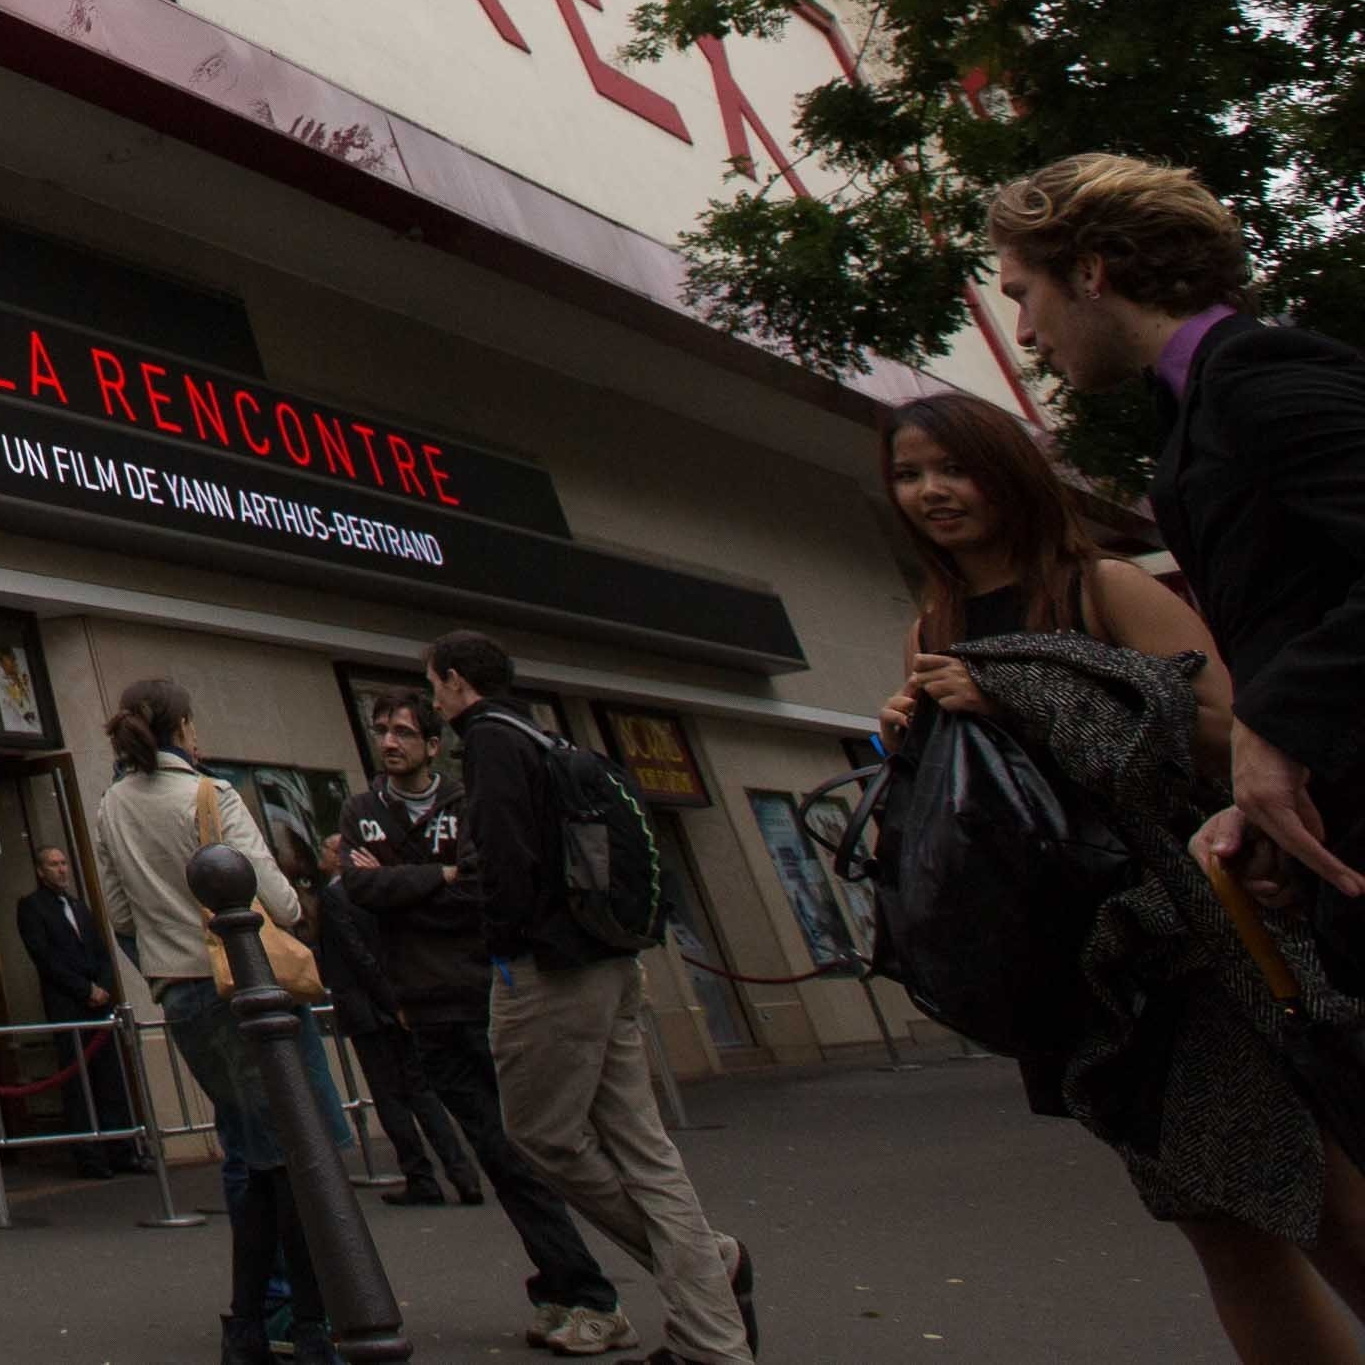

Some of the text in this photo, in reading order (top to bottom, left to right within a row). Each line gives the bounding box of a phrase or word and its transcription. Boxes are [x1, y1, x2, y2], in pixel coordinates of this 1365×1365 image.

[91, 348, 460, 506] RENCONTRE
[2, 434, 444, 567] UN FILM DE YANN ARTHUS-BERTRAND
